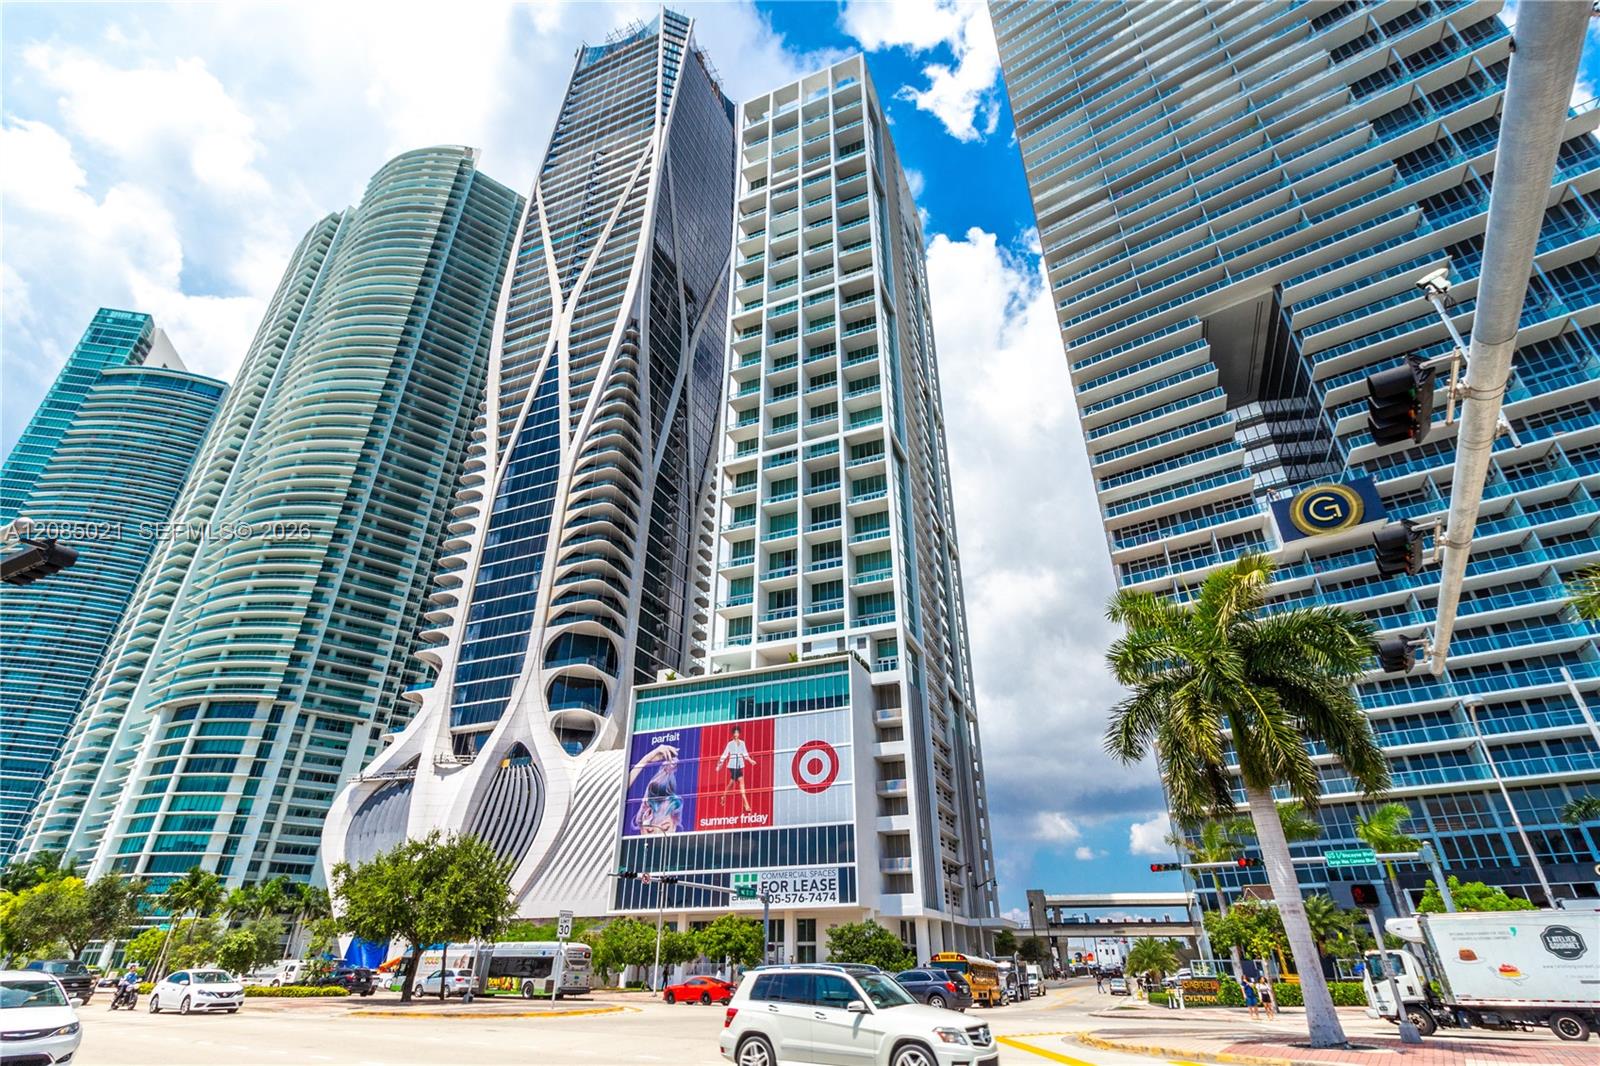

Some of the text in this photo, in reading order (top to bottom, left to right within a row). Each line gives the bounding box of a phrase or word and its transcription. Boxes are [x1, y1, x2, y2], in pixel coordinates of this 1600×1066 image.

[651, 732, 680, 745] parfait
[700, 813, 768, 826] summer friday
[761, 869, 837, 880] COMMERCIAL SPACES
[761, 880, 788, 894] FOR
[793, 878, 837, 892] LEASE
[761, 892, 837, 904] 05-576-7474
[559, 925, 569, 935] 30
